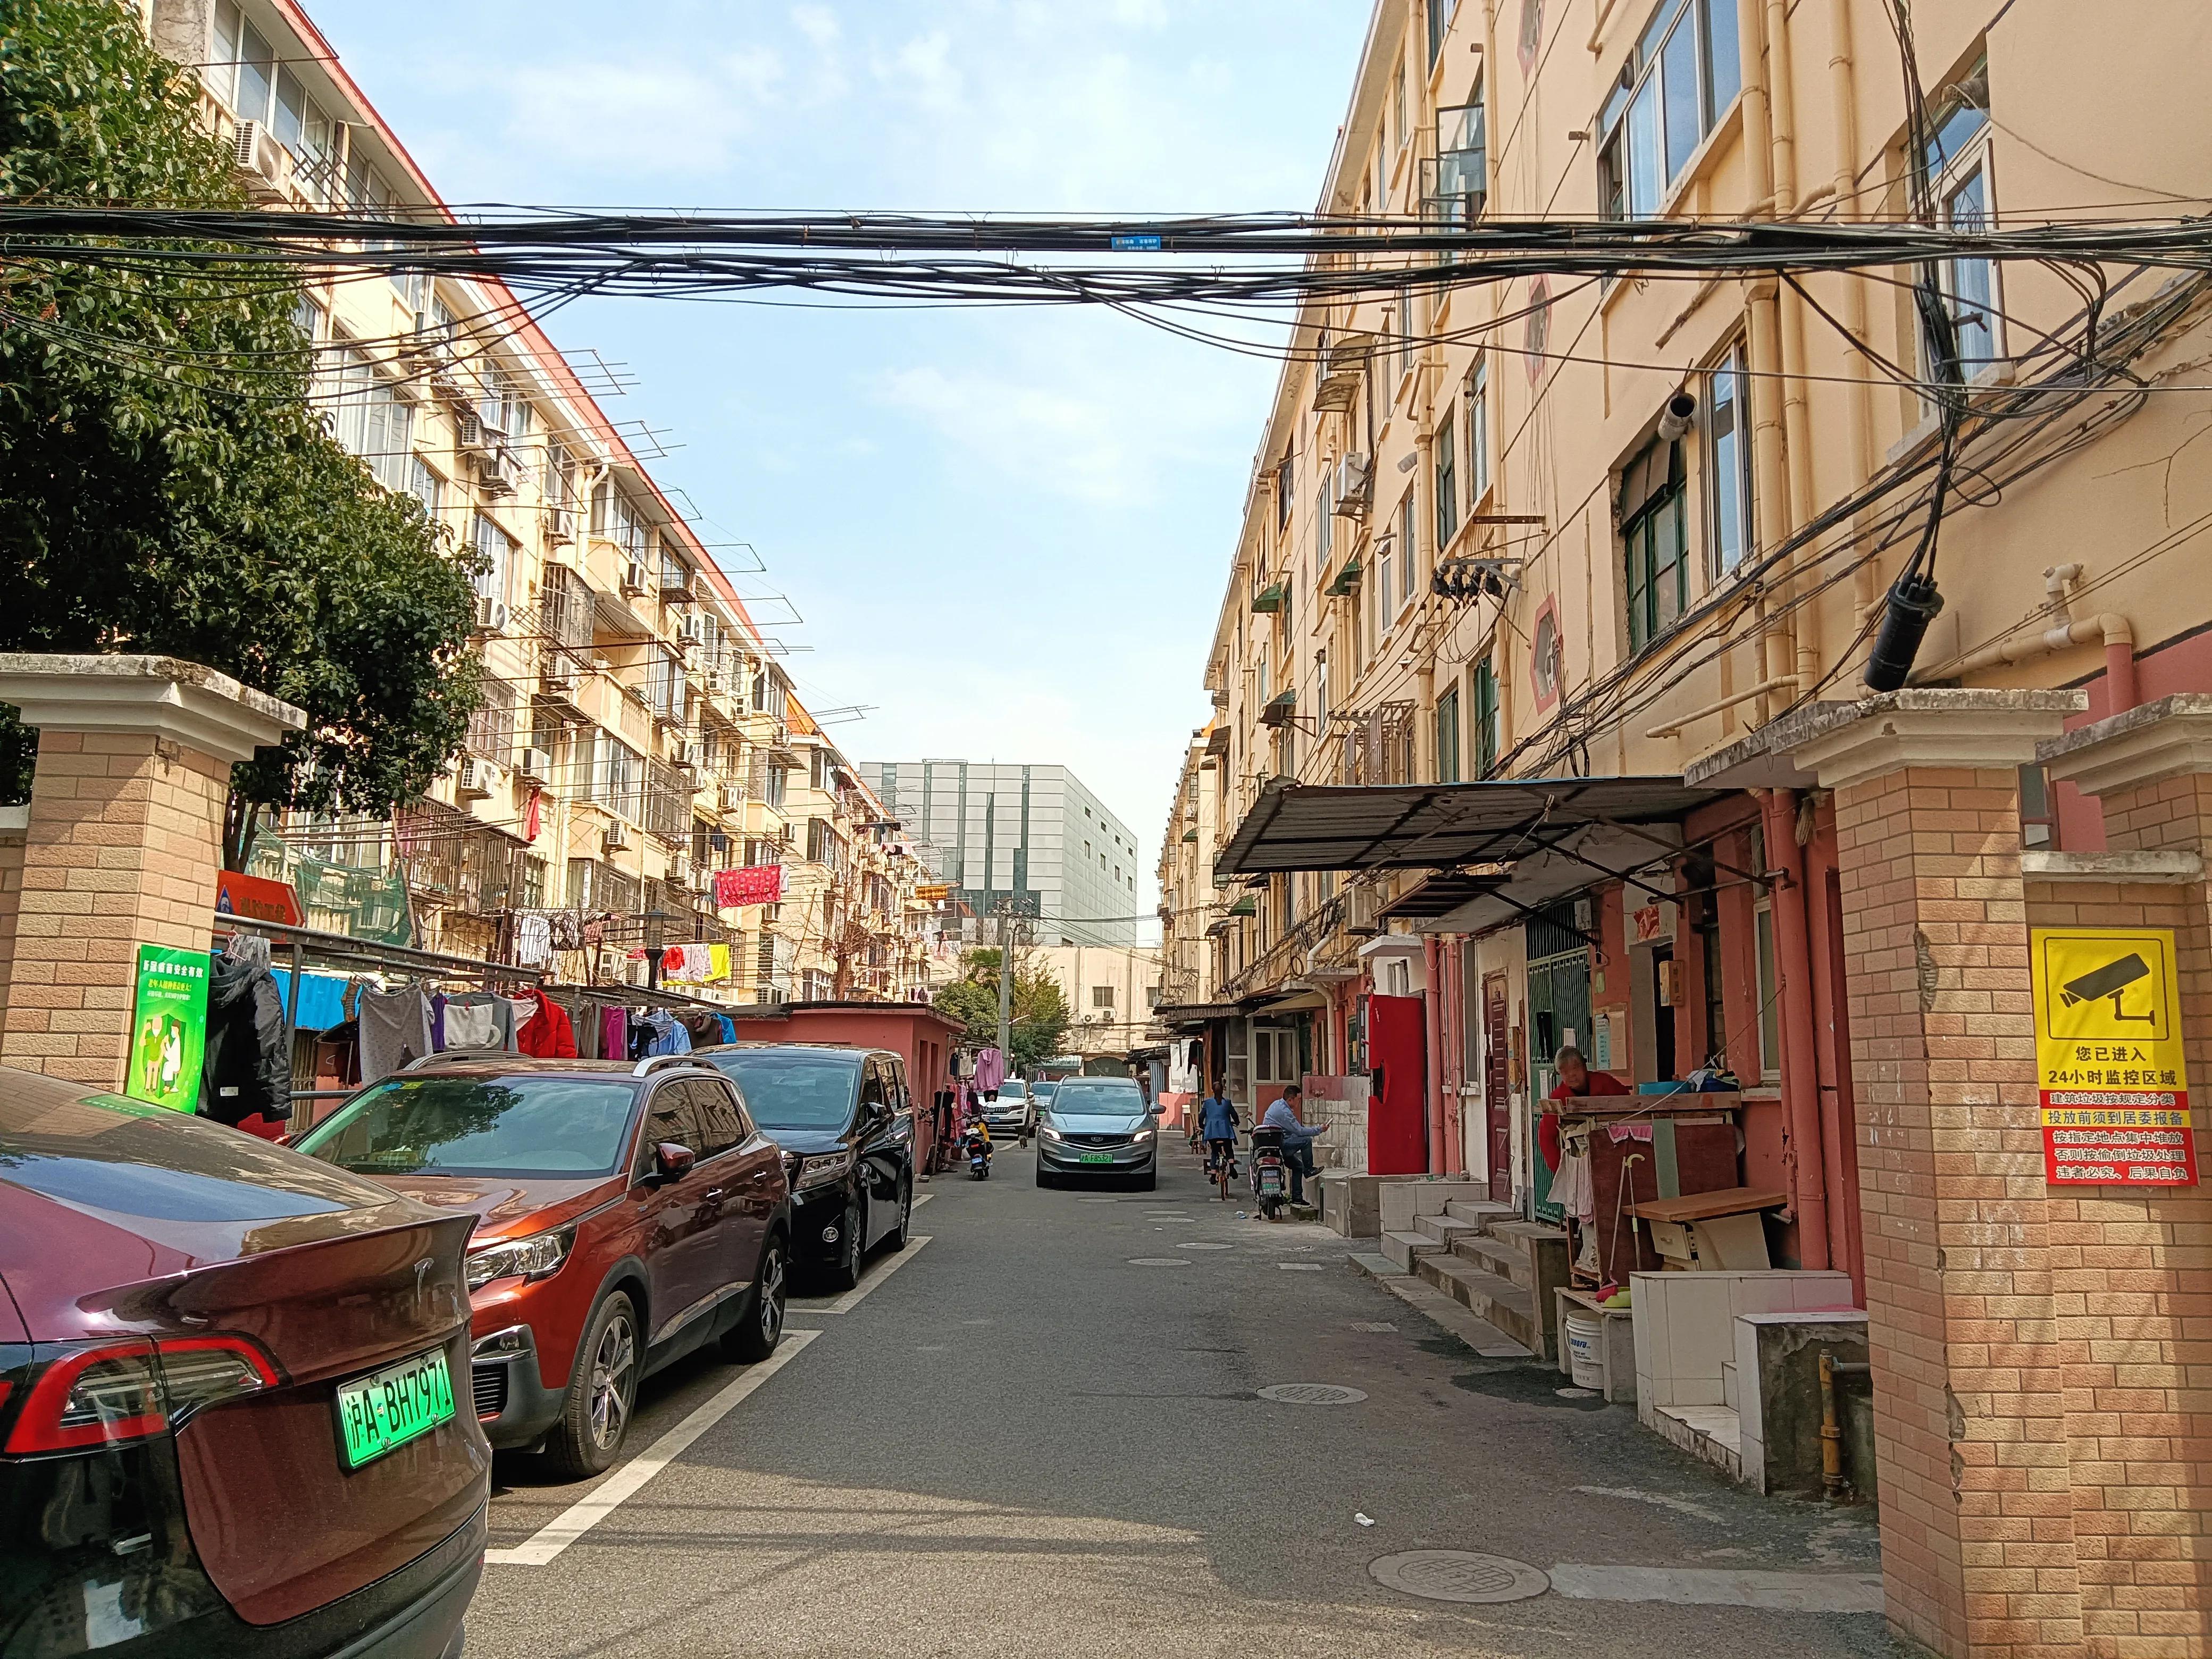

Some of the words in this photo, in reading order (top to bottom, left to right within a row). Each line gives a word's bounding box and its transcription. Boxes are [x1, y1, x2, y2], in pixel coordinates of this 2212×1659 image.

[143, 960, 203, 978] 新冠疫苗安全有效
[2075, 1046, 2147, 1062] 您已进入
[2048, 1069, 2177, 1085] 24小时监控区域
[2050, 1092, 2175, 1106] 建筑垃圾按规定分类
[2048, 1110, 2183, 1126] 投放前须到居委报备
[2053, 1130, 2184, 1144] 按指定地点集中堆放
[2055, 1149, 2186, 1162] 否则按偷倒垃圾处理
[2056, 1166, 2188, 1180] 违者必究、后果自负
